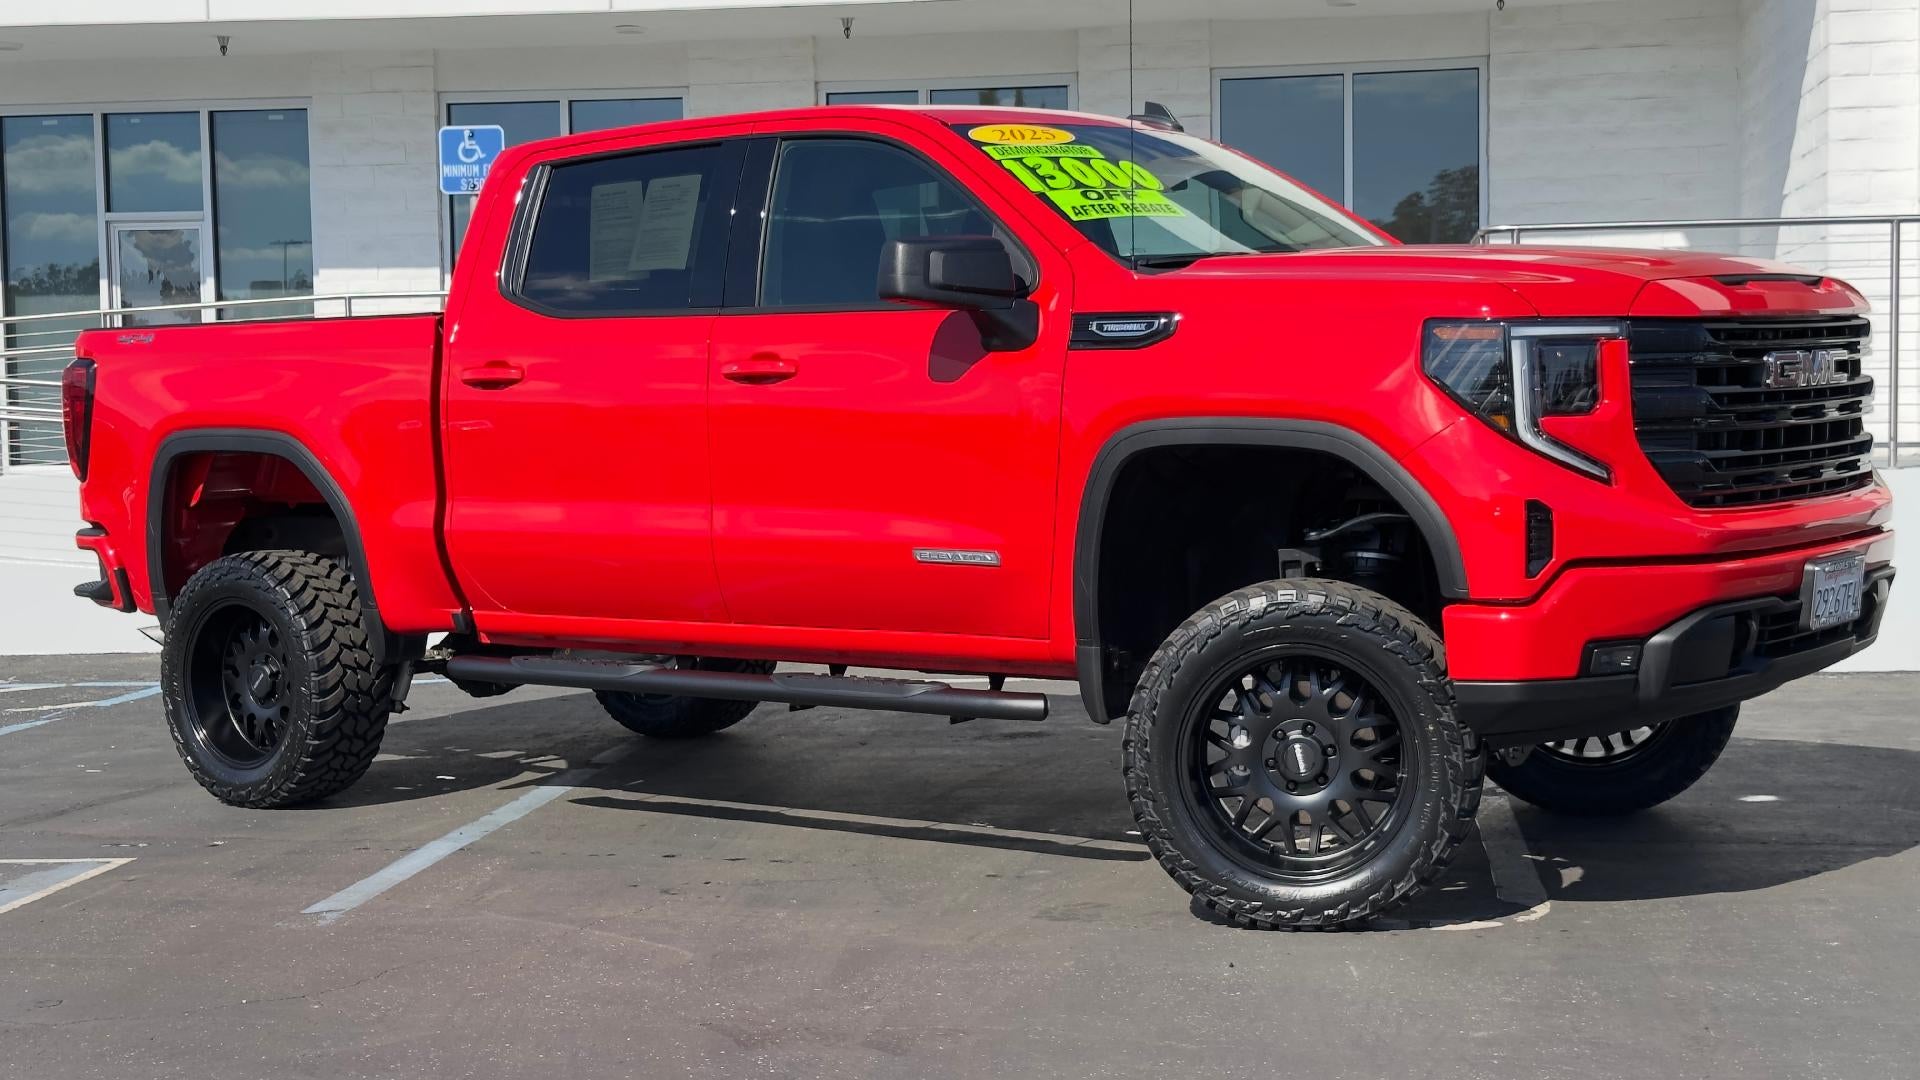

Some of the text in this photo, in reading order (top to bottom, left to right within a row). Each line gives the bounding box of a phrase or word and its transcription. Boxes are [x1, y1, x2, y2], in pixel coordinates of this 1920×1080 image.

[992, 128, 1056, 141] 2025
[993, 145, 1090, 156] DEMONSTRATOR
[443, 164, 480, 177] MINIMUM
[1001, 157, 1164, 192] 13000
[1080, 190, 1138, 201] OFF
[1071, 203, 1178, 217] AFTER REBATE
[1103, 323, 1148, 332] TURBOMAX
[1764, 350, 1848, 387] GMC
[919, 551, 993, 561] ELEVATION
